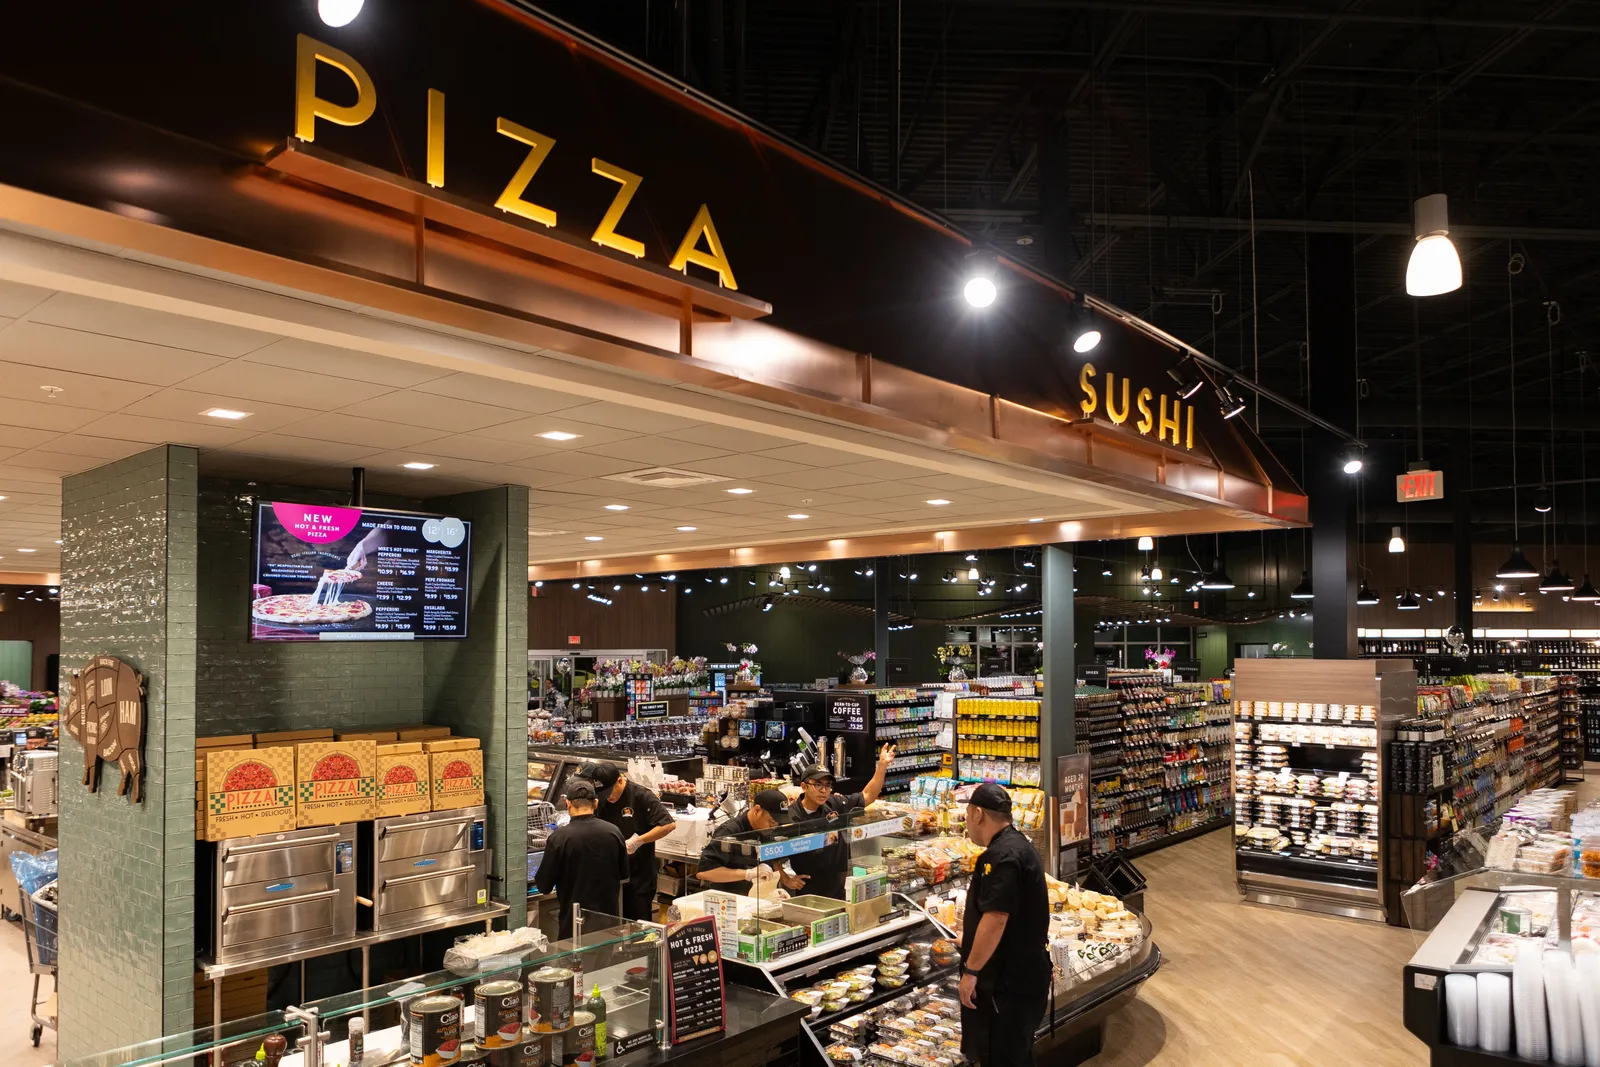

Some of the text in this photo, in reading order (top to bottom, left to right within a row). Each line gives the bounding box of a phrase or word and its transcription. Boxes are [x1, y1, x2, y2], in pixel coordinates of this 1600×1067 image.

[295, 33, 738, 290] PIZZA
[1080, 362, 1194, 449] SUSHI
[1404, 472, 1436, 498] EXIT
[303, 513, 333, 524] NEW
[100, 676, 113, 697] LOIN
[119, 700, 137, 725] HAM
[832, 707, 861, 715] COFFEE
[103, 739, 118, 757] BACON
[444, 778, 474, 791] PIZZA!
[1064, 774, 1077, 784] AGED
[314, 779, 361, 800] PIZZA!
[386, 782, 419, 798] PIZZA!
[1064, 783, 1084, 793] MONTHS
[227, 789, 278, 812] PIZZA!
[344, 798, 373, 806] DELICIOUS
[215, 815, 234, 823] FRESH
[261, 808, 293, 818] DELICIOUS
[764, 845, 784, 857] $5.00
[670, 939, 684, 949] HOT
[692, 932, 714, 944] FRESH
[683, 944, 703, 956] PIZZA
[501, 997, 520, 1007] Ciao
[440, 1013, 459, 1024] Ciao
[578, 1026, 594, 1037] Ciao
[523, 1044, 541, 1055] Ciao
